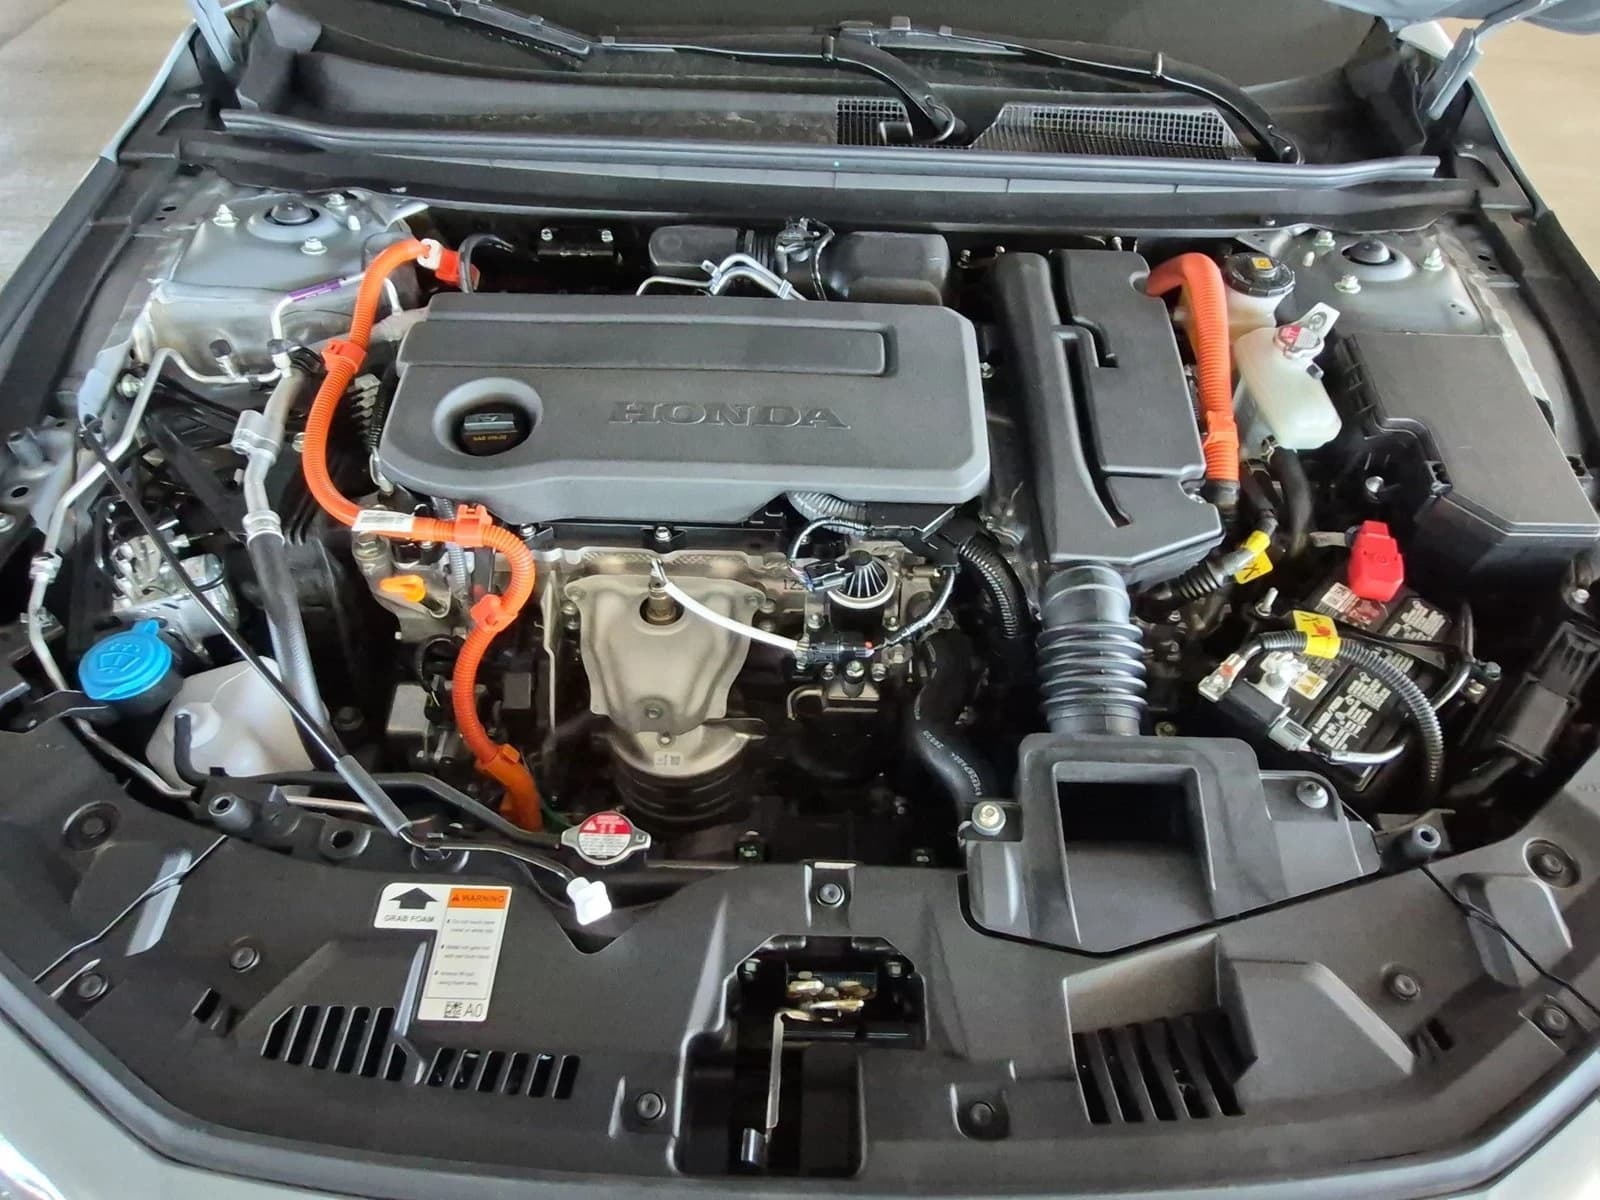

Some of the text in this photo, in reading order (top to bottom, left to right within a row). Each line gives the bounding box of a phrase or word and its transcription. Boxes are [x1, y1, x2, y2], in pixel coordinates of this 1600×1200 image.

[608, 400, 851, 430] HONDA
[461, 895, 505, 904] WARNING
[383, 914, 435, 923] GRAB FOAM
[463, 1002, 484, 1018] A0
